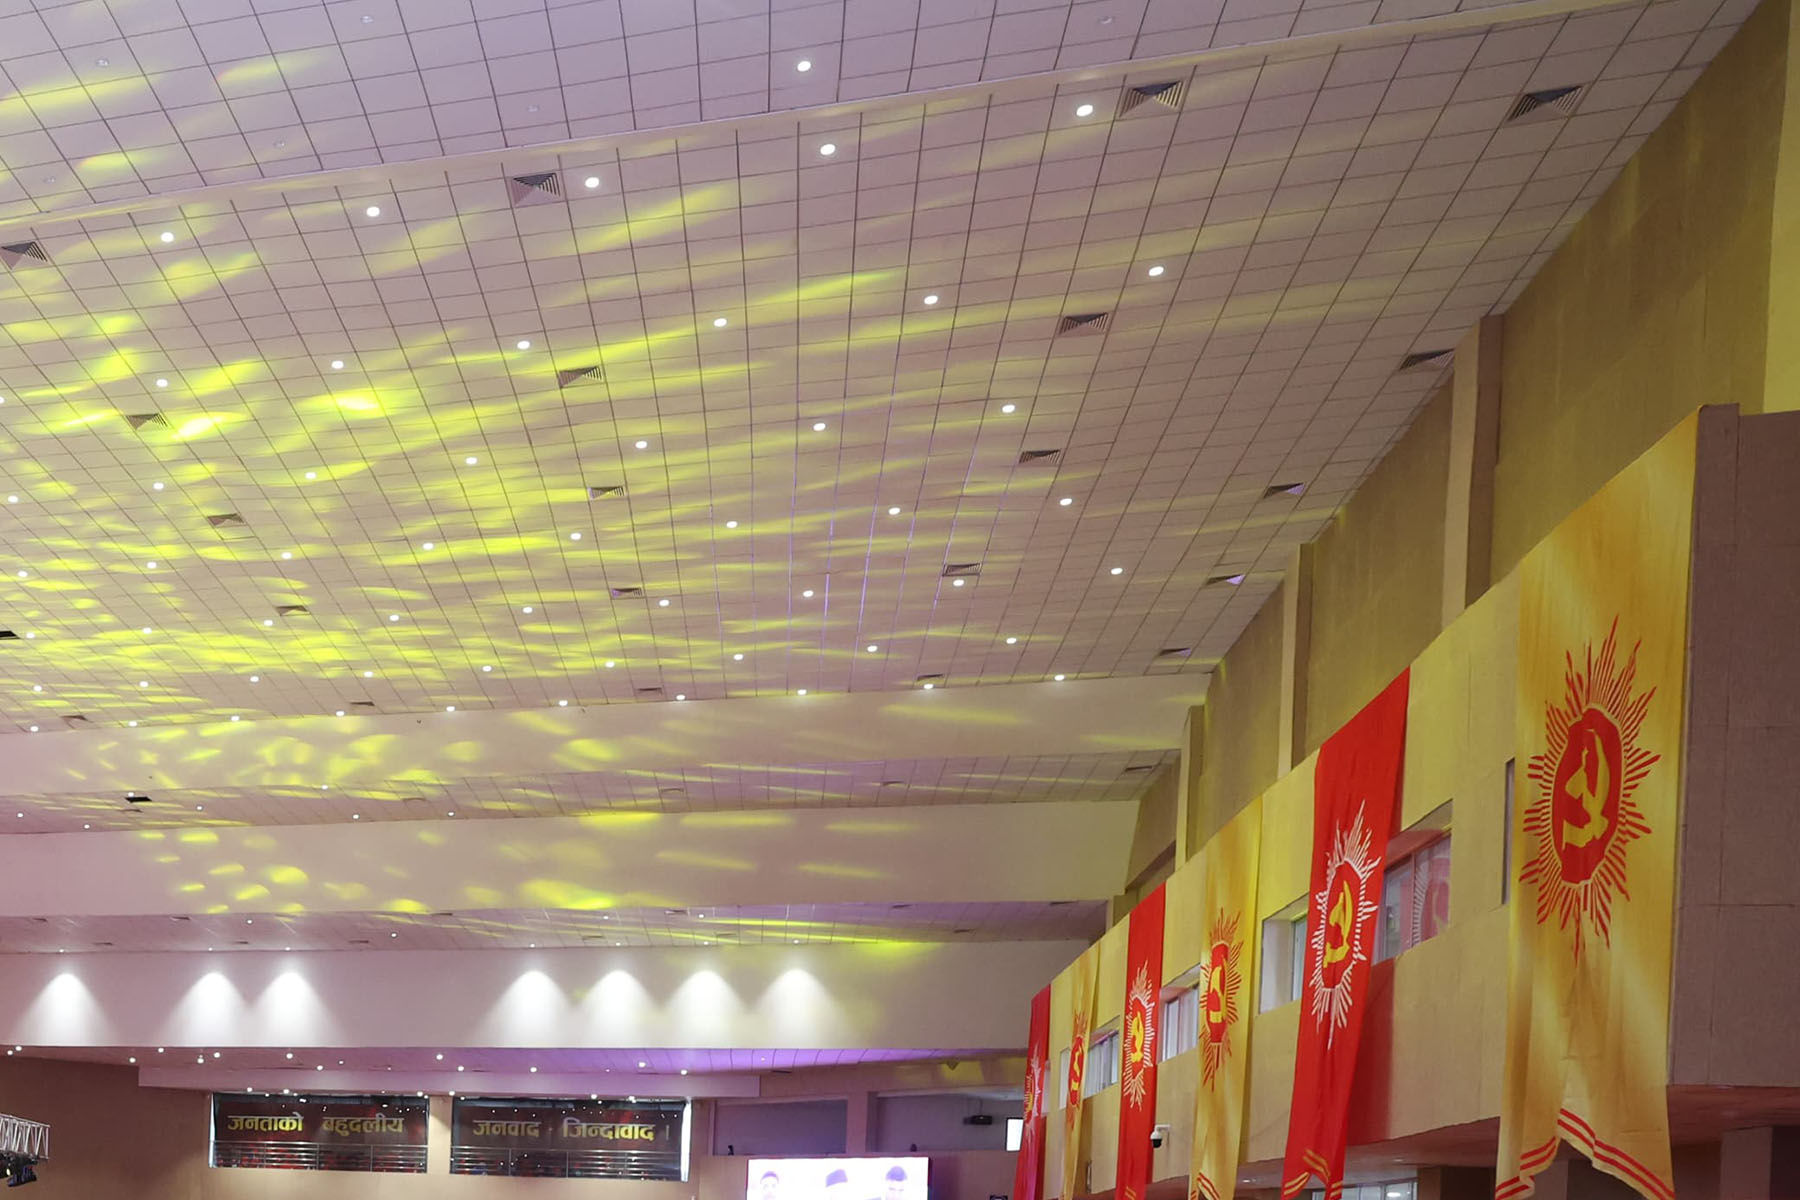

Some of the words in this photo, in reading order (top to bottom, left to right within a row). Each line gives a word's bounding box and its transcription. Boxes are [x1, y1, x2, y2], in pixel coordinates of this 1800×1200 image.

[227, 1111, 304, 1132] जनताको
[322, 1112, 405, 1137] बहुदलीय
[472, 1119, 542, 1138] जनवाद
[562, 1116, 657, 1141] जिन्दावाद
